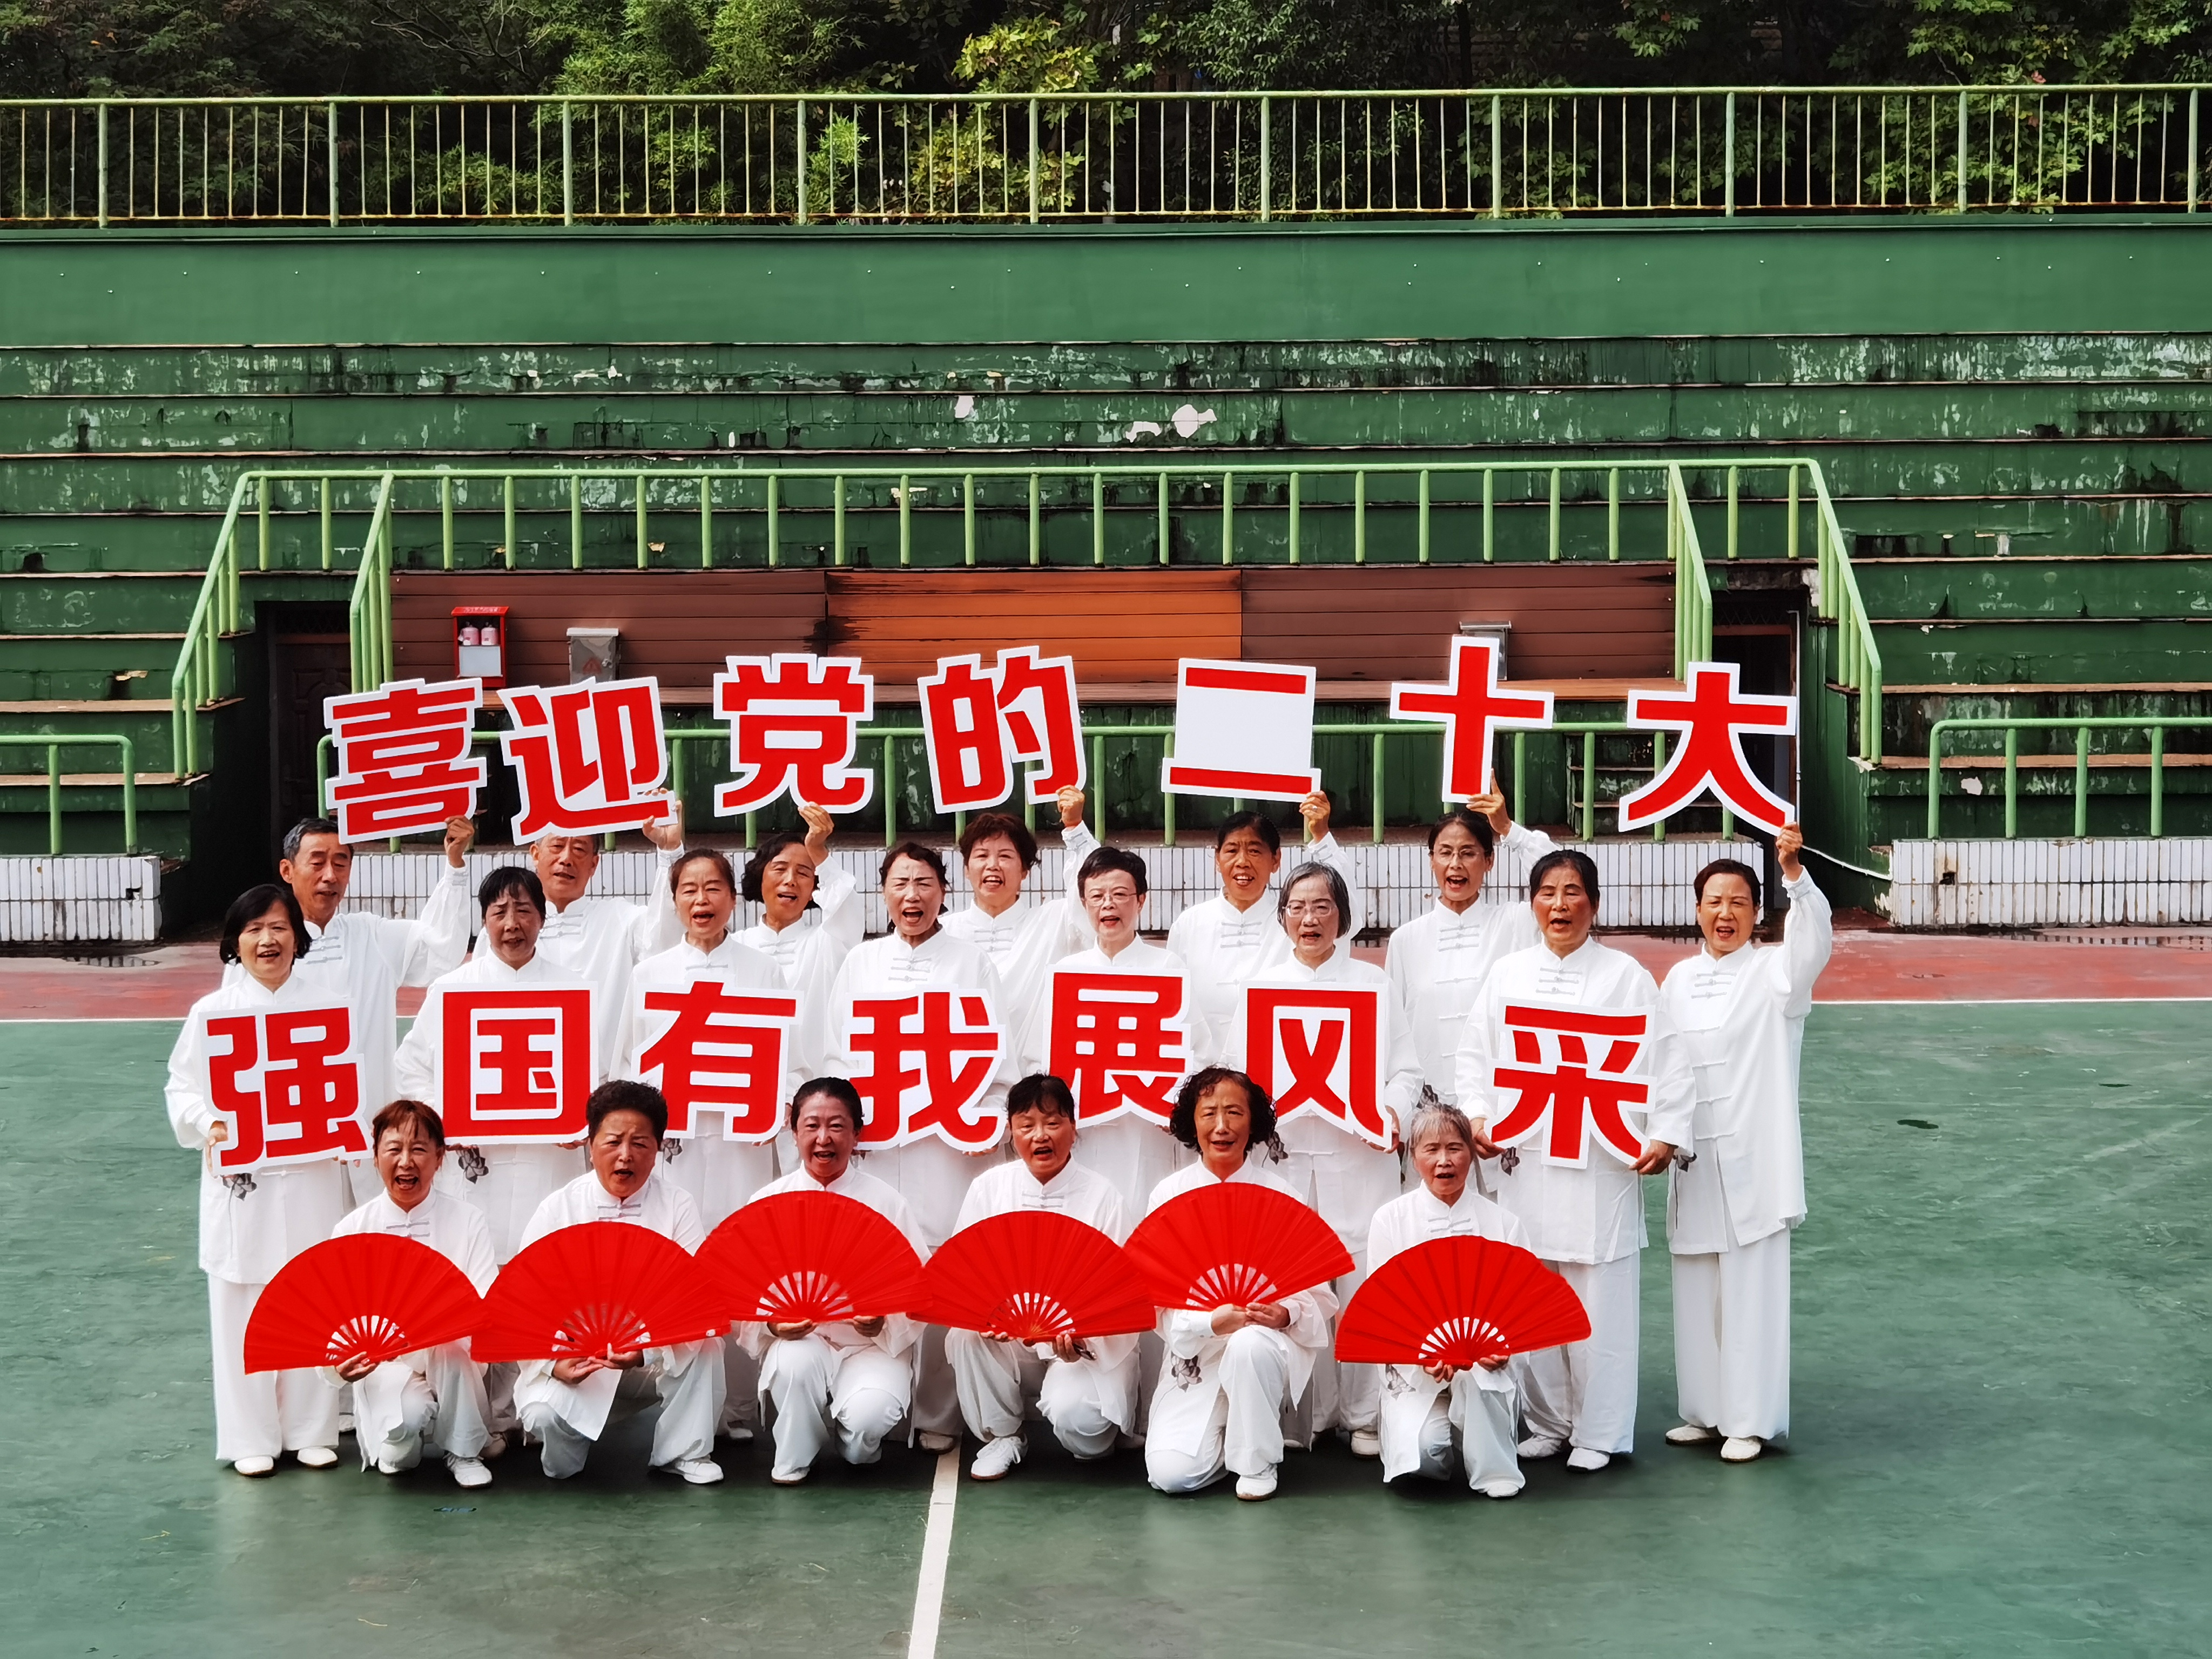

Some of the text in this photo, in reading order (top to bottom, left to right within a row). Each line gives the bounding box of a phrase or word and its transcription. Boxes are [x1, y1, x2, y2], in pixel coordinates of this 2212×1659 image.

[334, 646, 1786, 835] 喜 迎 党 的 二 十 大
[208, 973, 1648, 1166] 强 国 有 我 展 风 采
